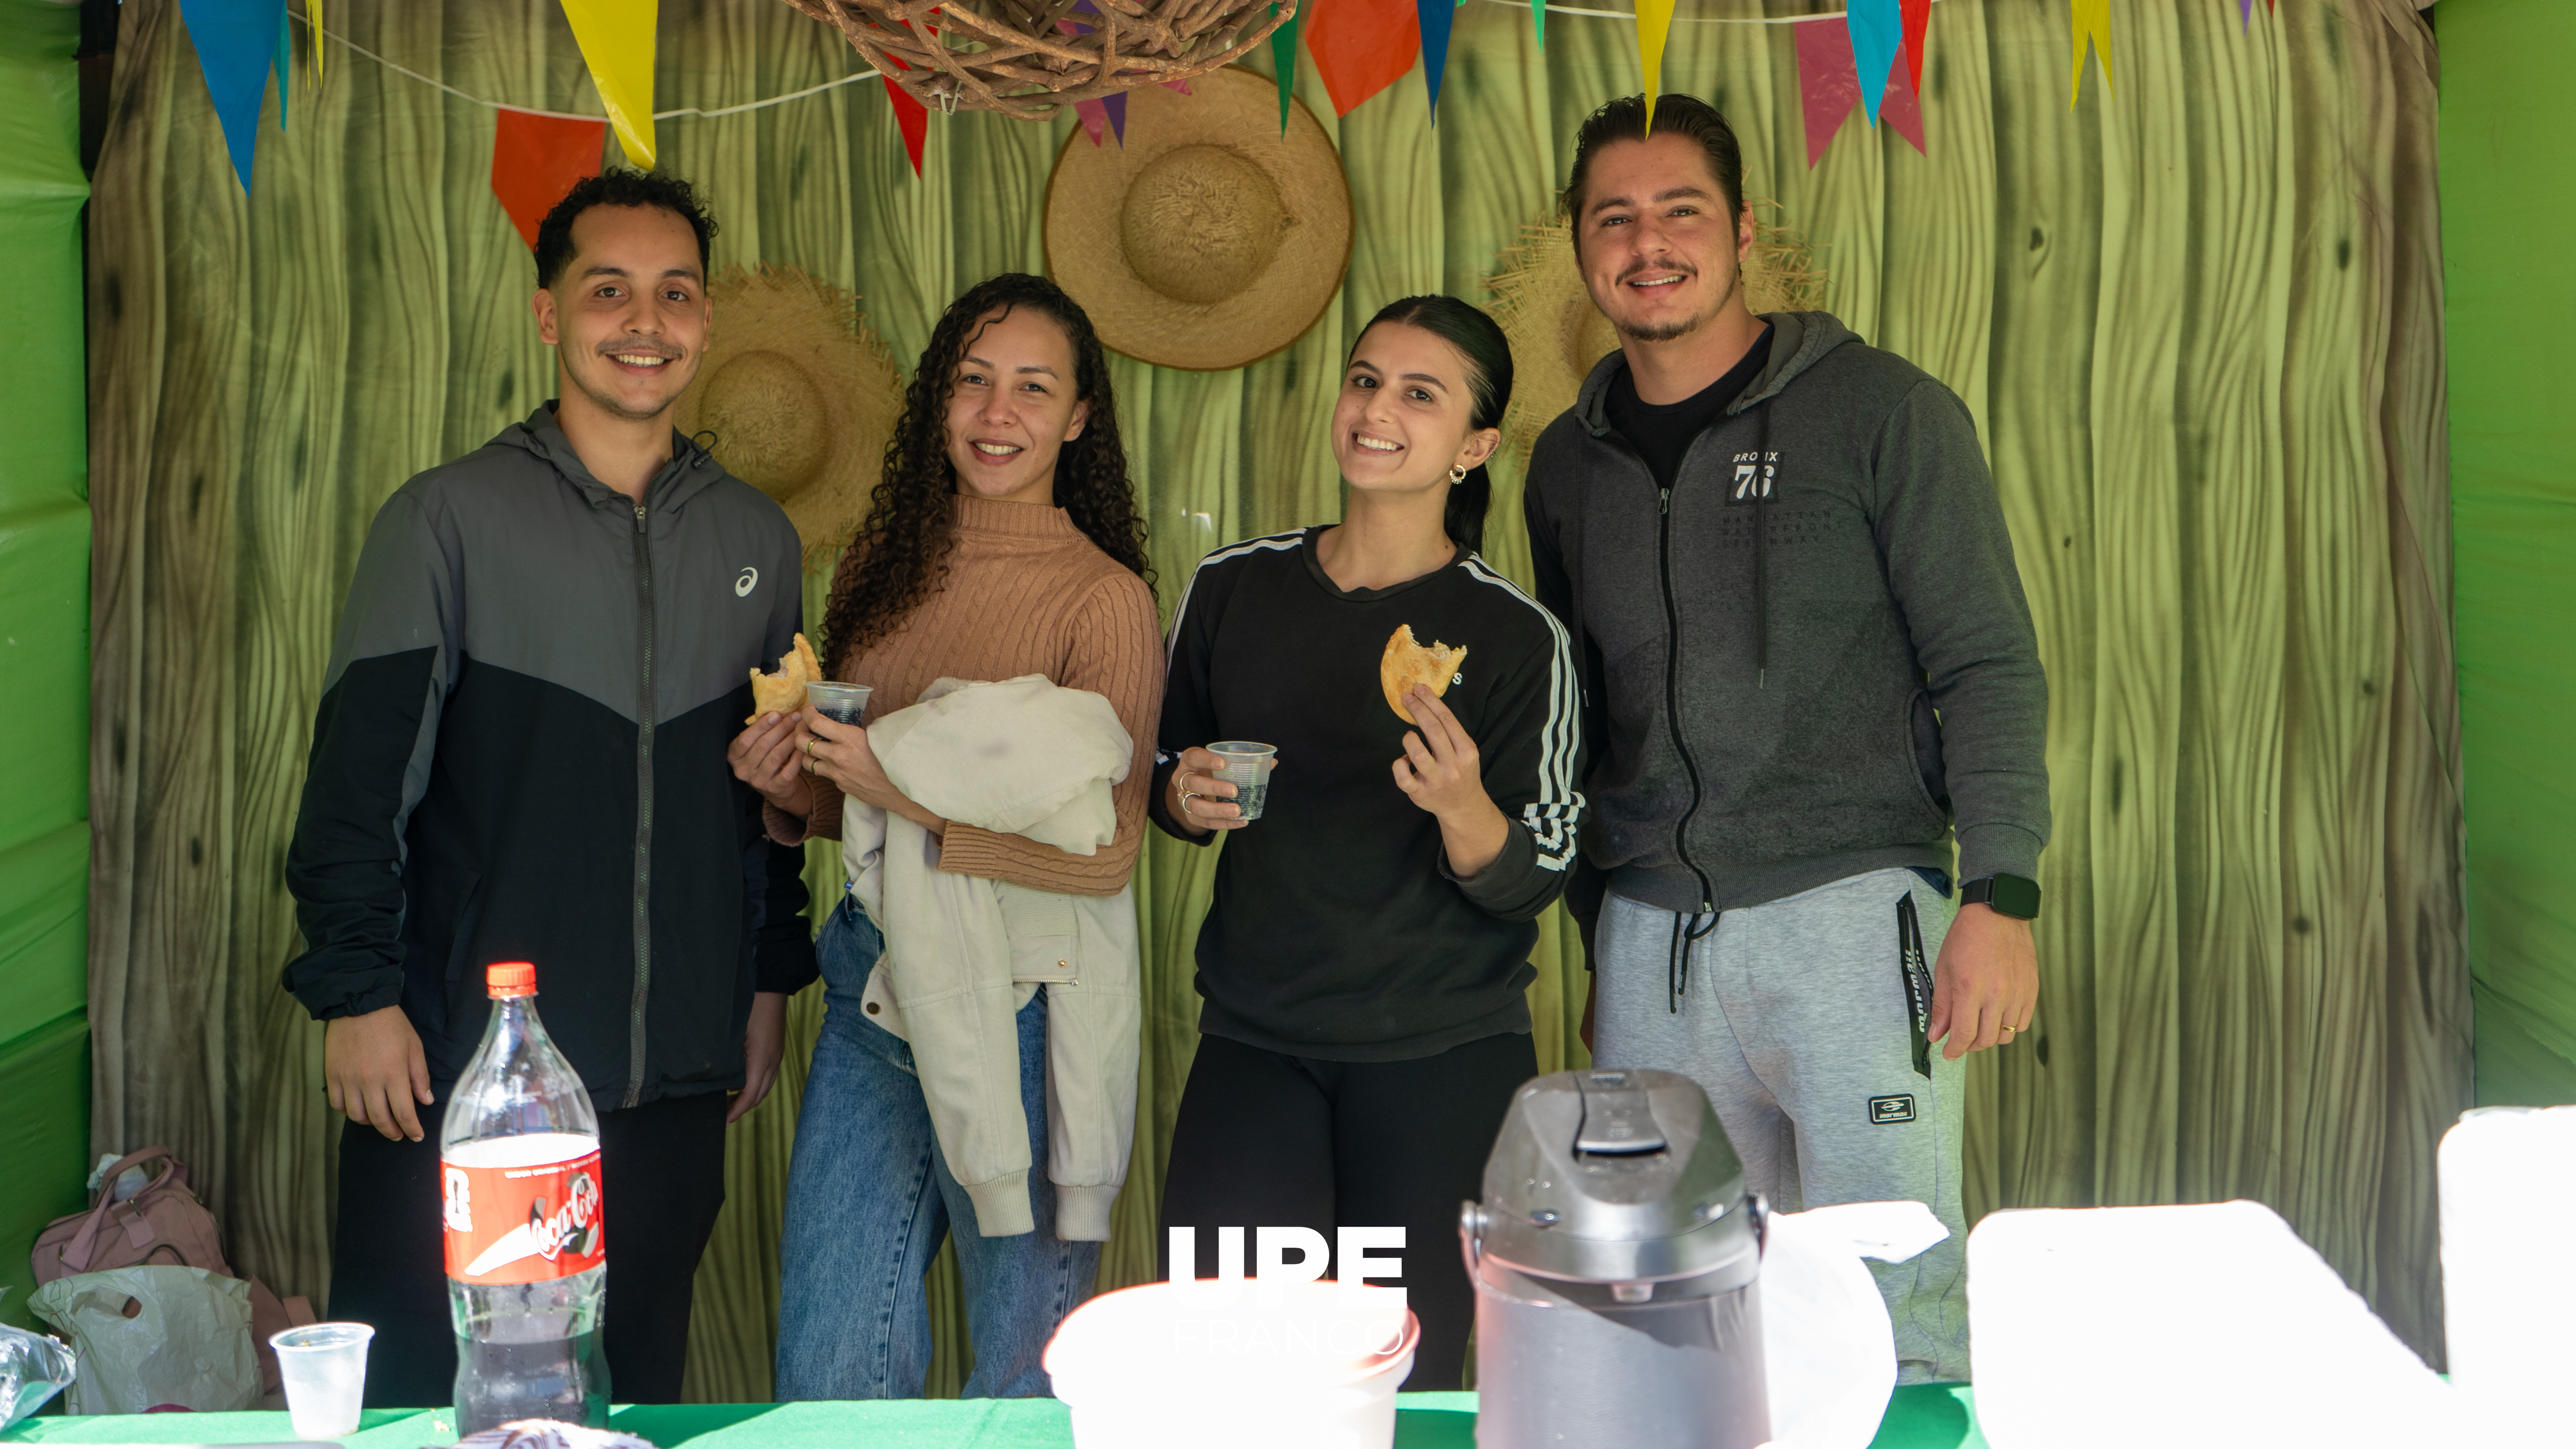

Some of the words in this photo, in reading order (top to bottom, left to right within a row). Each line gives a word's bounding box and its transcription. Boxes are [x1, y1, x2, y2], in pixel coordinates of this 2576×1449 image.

[1735, 465, 1775, 499] 76
[1723, 510, 1831, 524] MANATTAN
[1722, 522, 1842, 536] WATRFRONT
[1722, 535, 1819, 549] GRENWAY
